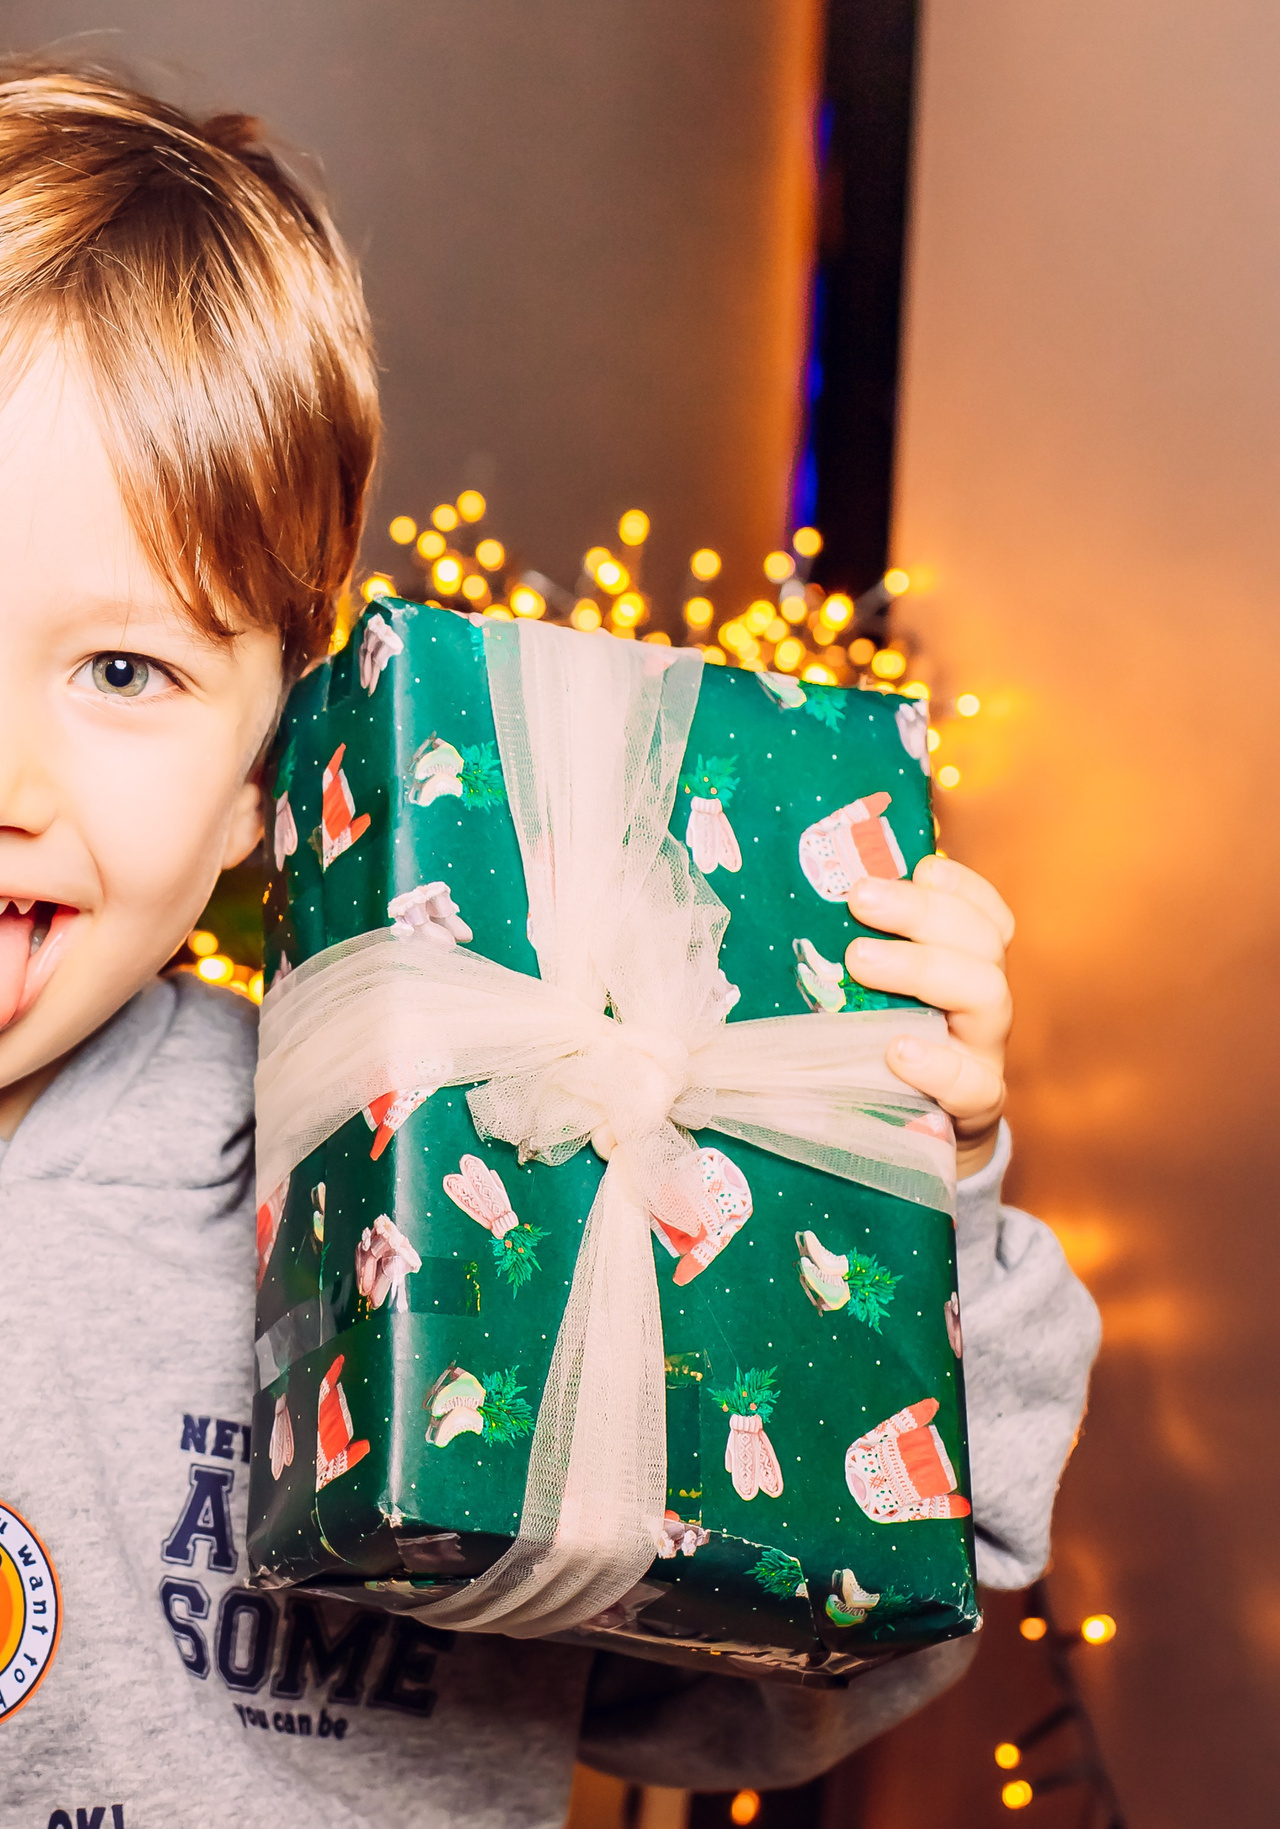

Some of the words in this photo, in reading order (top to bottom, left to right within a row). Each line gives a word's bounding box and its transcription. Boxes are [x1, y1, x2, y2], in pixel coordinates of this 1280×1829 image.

[17, 1544, 49, 1636] want
[14, 1652, 38, 1684] to
[159, 1574, 457, 1718] SOME
[232, 1702, 271, 1731] you
[272, 1711, 313, 1736] can
[318, 1708, 349, 1740] be
